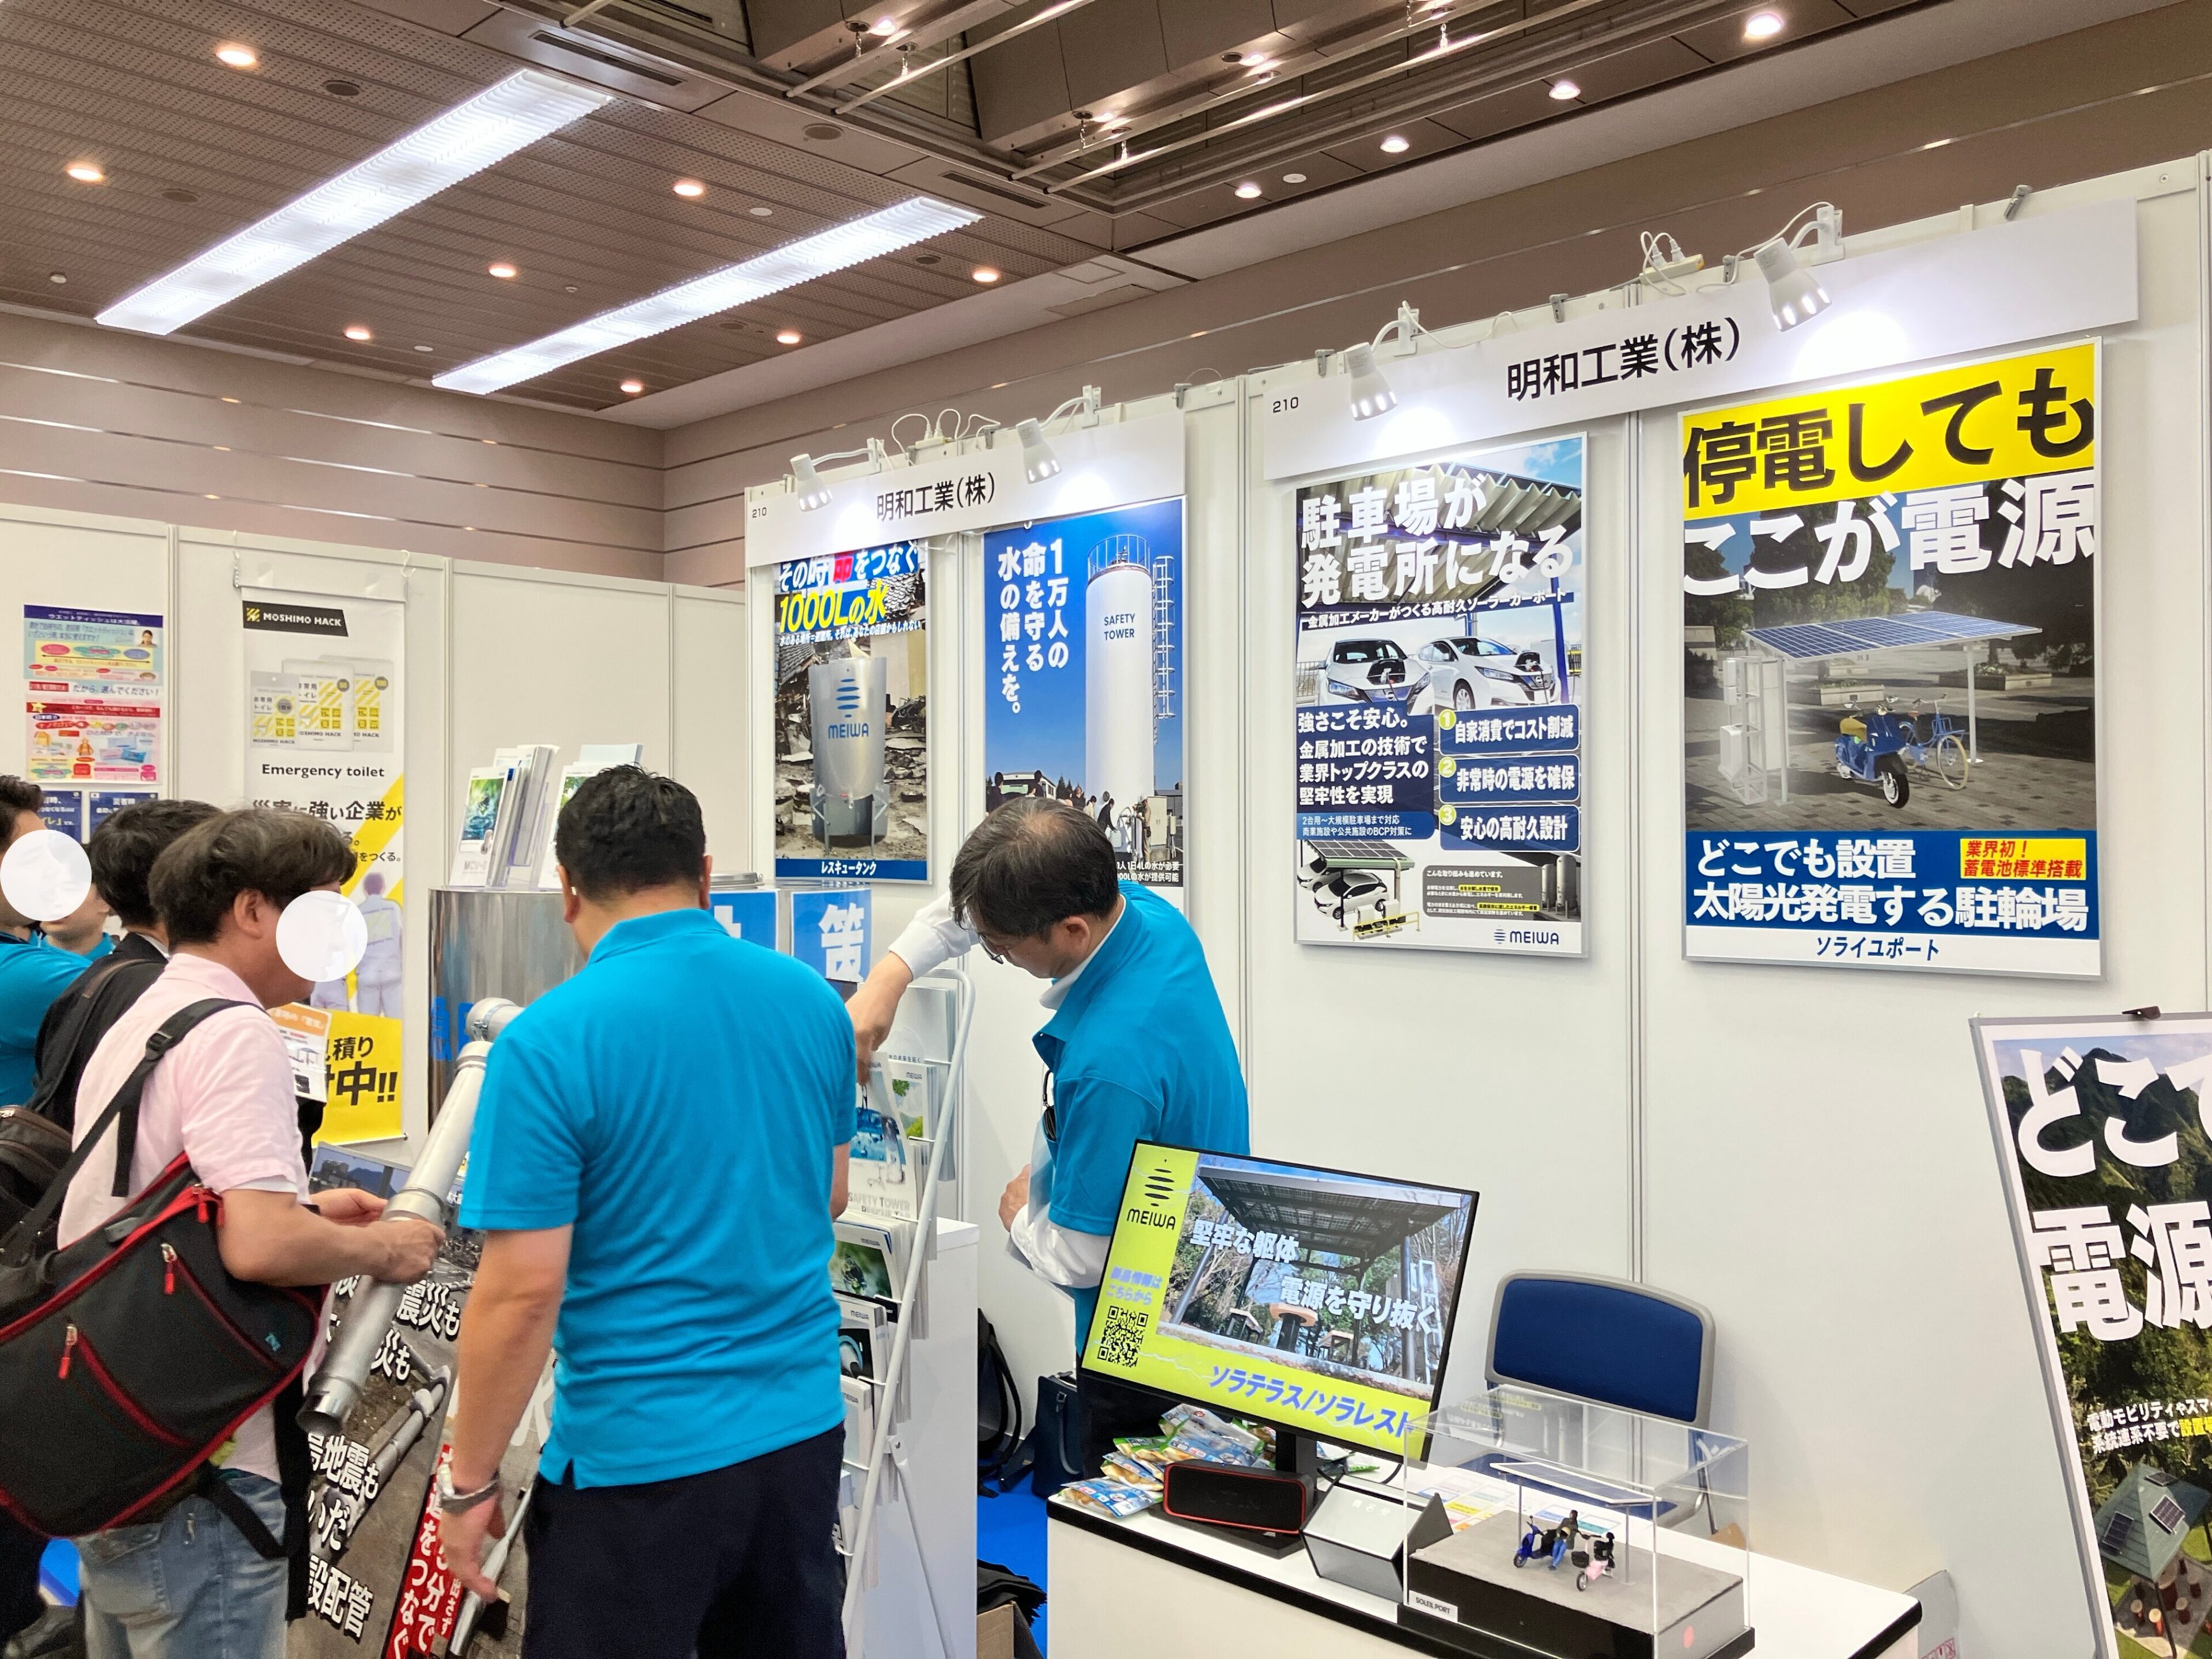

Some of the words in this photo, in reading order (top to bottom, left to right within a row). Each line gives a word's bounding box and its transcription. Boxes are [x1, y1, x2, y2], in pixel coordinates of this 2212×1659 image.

[1507, 317, 1740, 402] 明和工業(株)
[1272, 396, 1299, 414] 210
[1683, 368, 2094, 509] 停電しても
[876, 472, 995, 521] 明和工業(株)
[752, 507, 767, 519] 210
[1301, 474, 1487, 551] 駐車場が
[1684, 469, 2094, 596] ここが電源
[1301, 525, 1574, 609] 発電所になる
[779, 578, 889, 633] 1000Lの水
[1022, 542, 1047, 672] 命を守る
[1047, 538, 1069, 669] 1万人の
[1308, 588, 1567, 629] 金属加工メーカーがつくる高耐久ソーラーカーポート
[263, 612, 312, 624] MOSHIMO
[314, 616, 342, 627] HACK
[998, 546, 1022, 714] 水の備えを。
[1104, 613, 1135, 627] SAFETY
[1104, 628, 1135, 641] TOWER
[828, 723, 869, 740] MEIWA
[1298, 709, 1408, 734] 強さこそ安心。
[1442, 713, 1453, 727] 1
[1455, 715, 1574, 744] 自家消費でコスト削減
[1299, 736, 1428, 759] 金属加工の技術で
[262, 764, 342, 778] Emergency
[347, 767, 385, 777] toilet
[1299, 761, 1429, 783] 業界トップクラスの
[1442, 760, 1453, 772] 2
[1457, 765, 1575, 793] 非常時の電源を確保
[1300, 785, 1393, 806] 堅牢性を実現
[1442, 809, 1453, 823] 3
[1460, 815, 1568, 841] 安心の高耐久設計
[1302, 827, 1412, 836] 商業施設や公共施設のBCP対策に
[821, 860, 877, 876] レスキュータンク
[1697, 839, 1916, 879] どこでも設置
[1963, 859, 2082, 879] 蓄電池標準搭載
[1693, 882, 2089, 931] 太陽光発電する駐輪場
[1510, 930, 1559, 945] MEIWA
[1816, 936, 1940, 961] ソライユポート
[1126, 1208, 1176, 1230] MEIWA
[2030, 1201, 2212, 1341] 電源
[850, 1310, 869, 1320] MEIWA
[1279, 1275, 1434, 1334] 電源を守り抜く
[1209, 1364, 1415, 1438] ソラテラス/ソラレスト
[2086, 1398, 2212, 1432] 電動モビリティやスマ
[1415, 1597, 1434, 1608] SOLEIL
[1435, 1603, 1450, 1615] PORT
